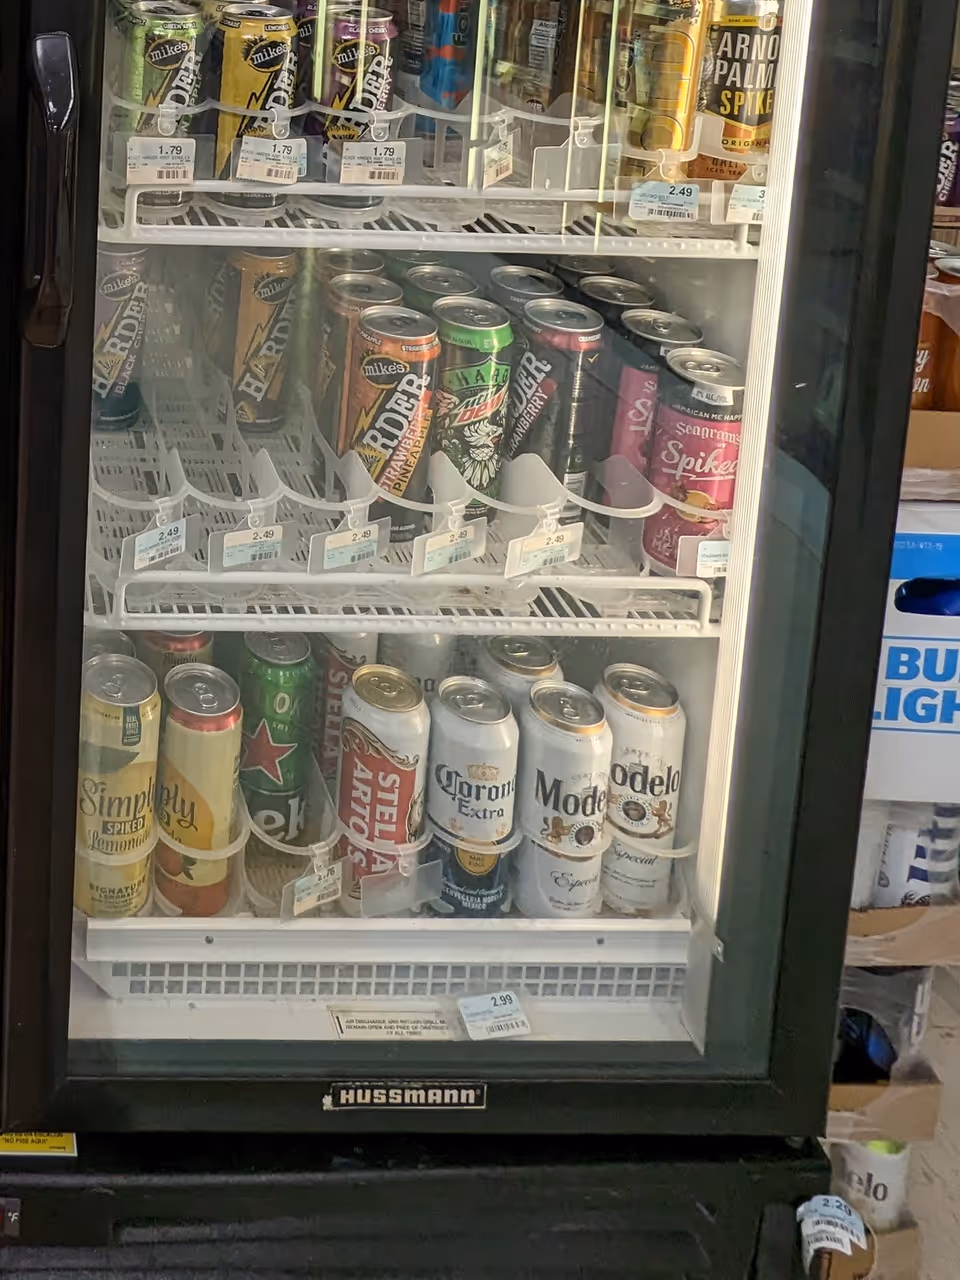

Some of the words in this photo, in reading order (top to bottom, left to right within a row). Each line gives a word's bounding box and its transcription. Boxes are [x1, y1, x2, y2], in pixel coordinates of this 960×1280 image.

[150, 41, 189, 62] mike's
[251, 42, 288, 65] mike's
[717, 31, 780, 61] ARNO
[714, 60, 777, 89] PALM
[158, 145, 182, 156] 1.79
[272, 144, 293, 156] 1.79
[373, 146, 395, 157] 1.79
[669, 185, 693, 197] 2.49
[102, 274, 138, 296] mike's
[115, 354, 137, 395] BLACK
[363, 362, 405, 376] mike's
[363, 373, 430, 455] RDER
[711, 413, 723, 421] ME
[158, 526, 180, 541] 2.49
[252, 529, 275, 541] 2.49
[351, 529, 372, 542] 2.49
[449, 529, 468, 542] 2.49
[545, 534, 565, 546] 2.49
[884, 645, 960, 684] BU
[609, 761, 681, 798] odelo
[535, 767, 608, 818] Mode
[456, 799, 505, 820] Extra
[106, 818, 145, 834] SPIKED
[490, 993, 514, 1008] 2.99
